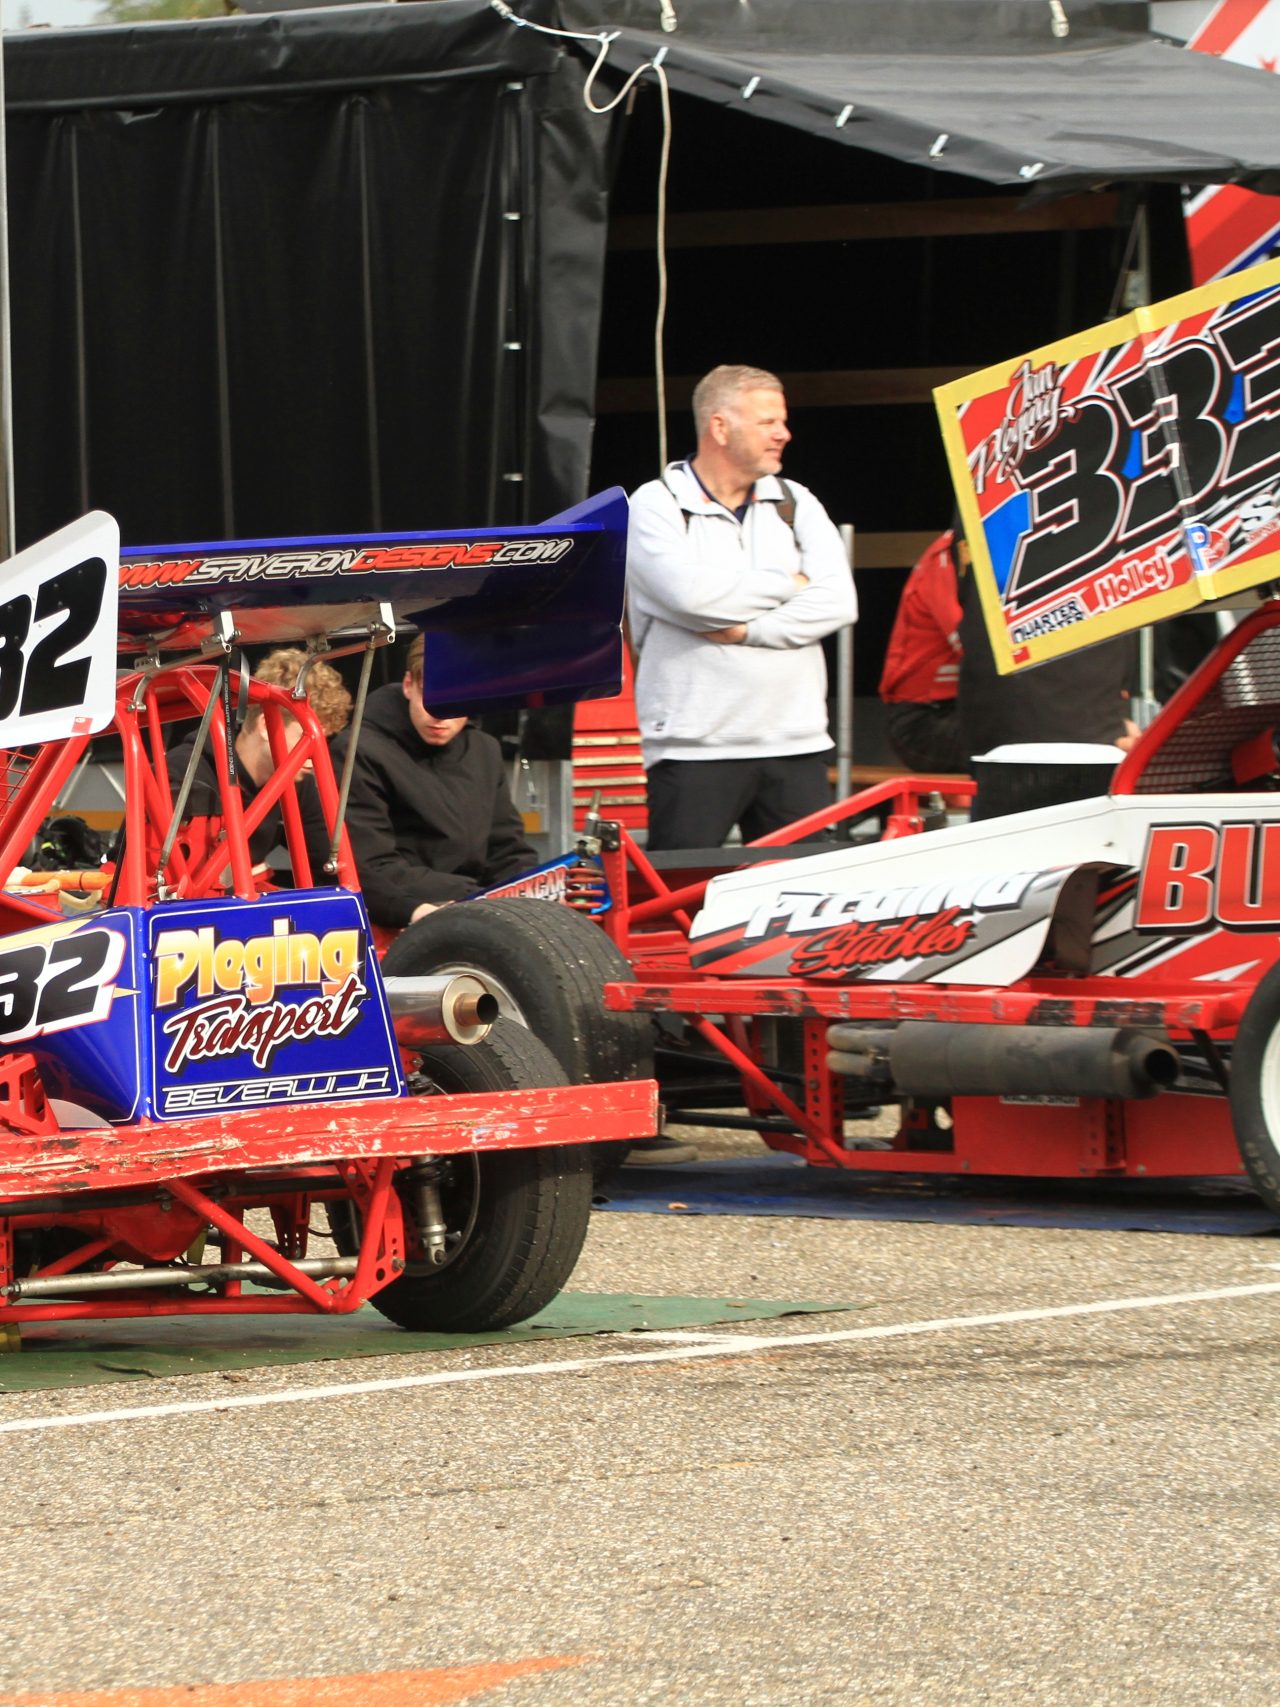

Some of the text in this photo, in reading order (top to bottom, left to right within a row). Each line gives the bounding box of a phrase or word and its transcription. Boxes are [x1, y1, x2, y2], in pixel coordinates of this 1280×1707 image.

[155, 918, 363, 1007] Pleging
[788, 906, 973, 975] Stables
[164, 973, 367, 1073] Transport
